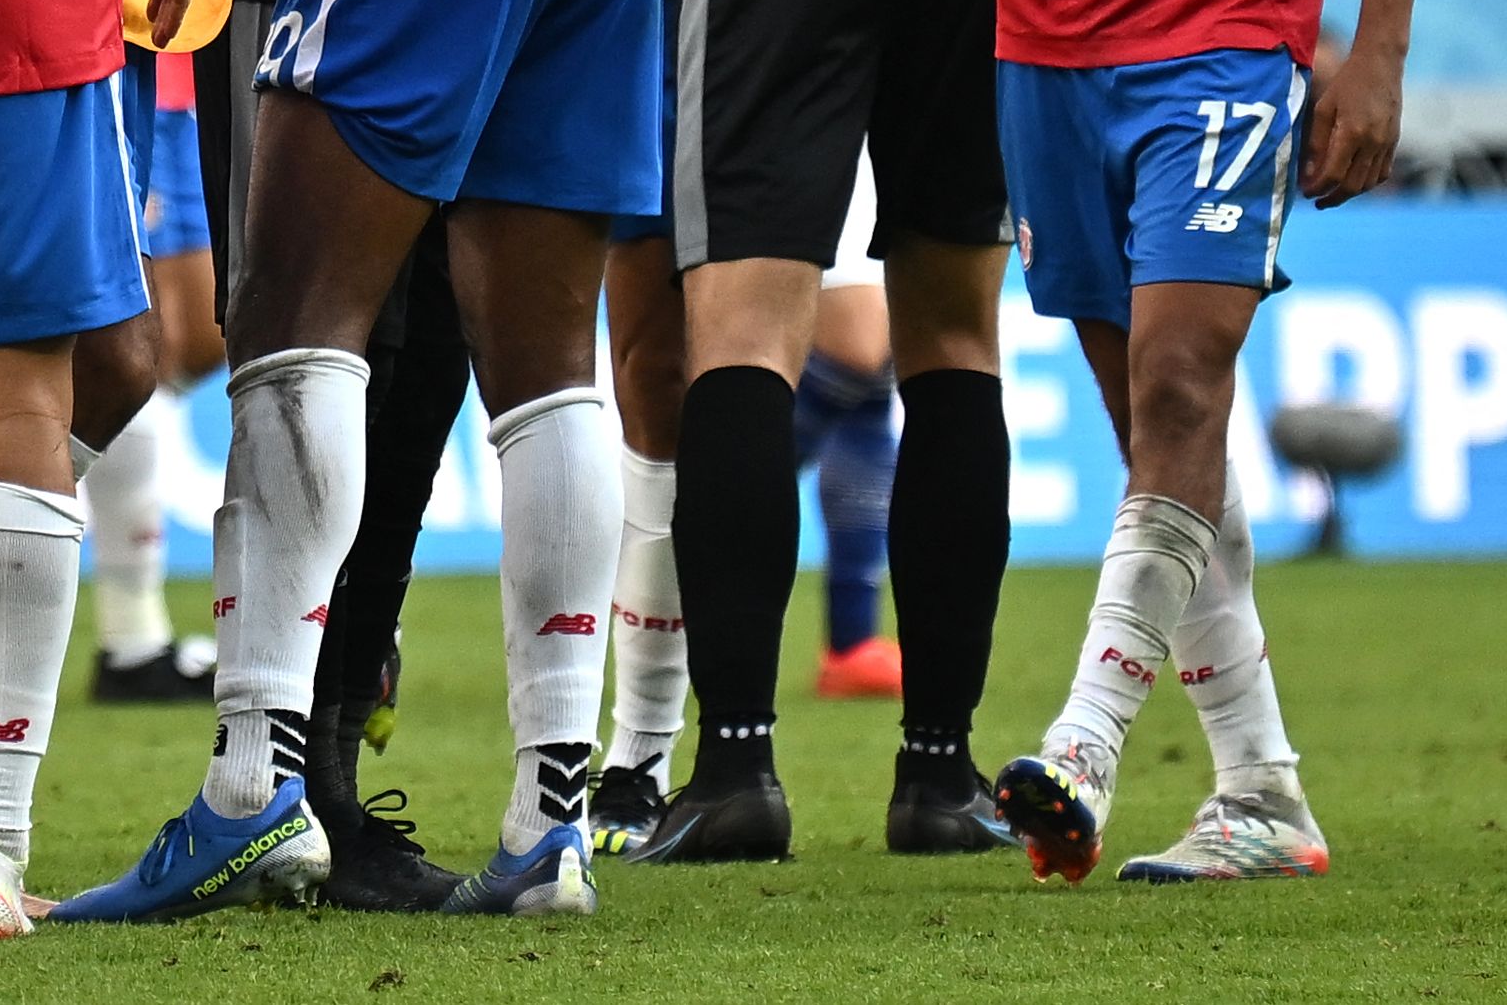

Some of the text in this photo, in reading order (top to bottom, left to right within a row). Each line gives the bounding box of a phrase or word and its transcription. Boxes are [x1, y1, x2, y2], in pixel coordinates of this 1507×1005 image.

[1194, 100, 1277, 191] 17
[193, 817, 307, 900] new balance
